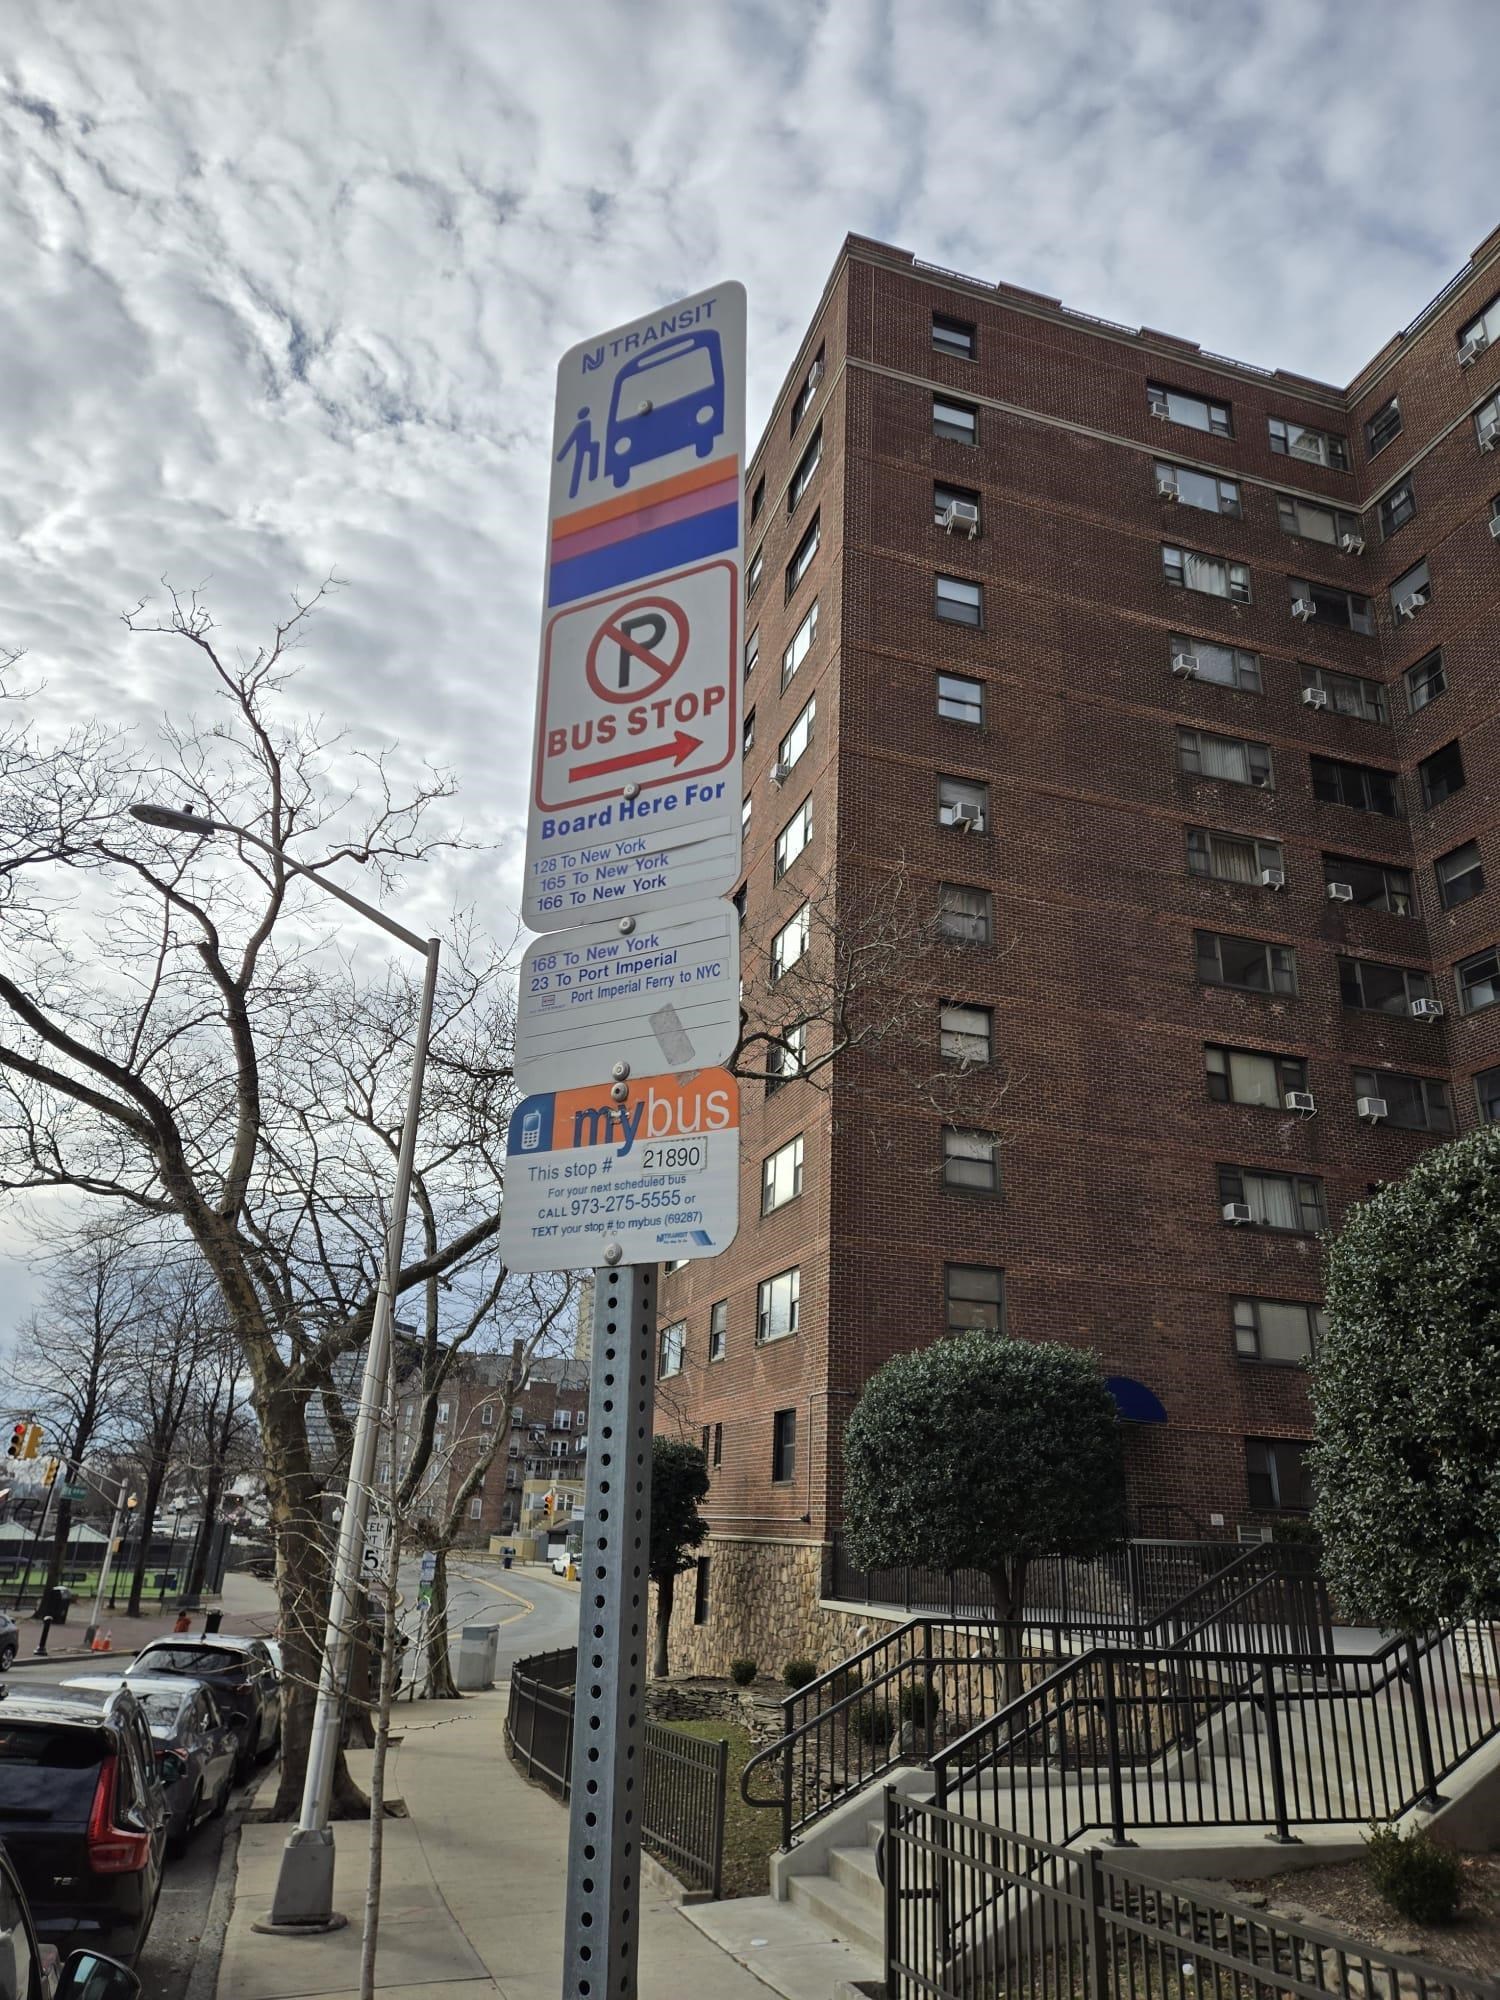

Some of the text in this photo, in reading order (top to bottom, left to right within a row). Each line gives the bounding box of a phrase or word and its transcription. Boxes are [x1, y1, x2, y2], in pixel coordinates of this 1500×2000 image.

[610, 299, 717, 358] TRANSIT
[618, 613, 666, 688] P
[548, 685, 726, 758] BUS STOP
[542, 781, 726, 840] Board Here For
[533, 838, 646, 874] 128 To New York
[541, 853, 669, 892] 165 To New York
[537, 874, 666, 911] 166 To New York
[531, 950, 677, 991] 23 To Port Imperial
[532, 934, 659, 972] 168 To New York
[571, 963, 720, 1004] Port Imperial Ferry to NYC
[573, 1088, 730, 1158] mybus
[528, 1147, 700, 1182] This stop # 21890
[538, 1190, 696, 1219] CALL 973-275-5555 or
[548, 1175, 686, 1198] For your next scheduled bus
[532, 1210, 702, 1238] TEXT your stop # to mybus (69287)
